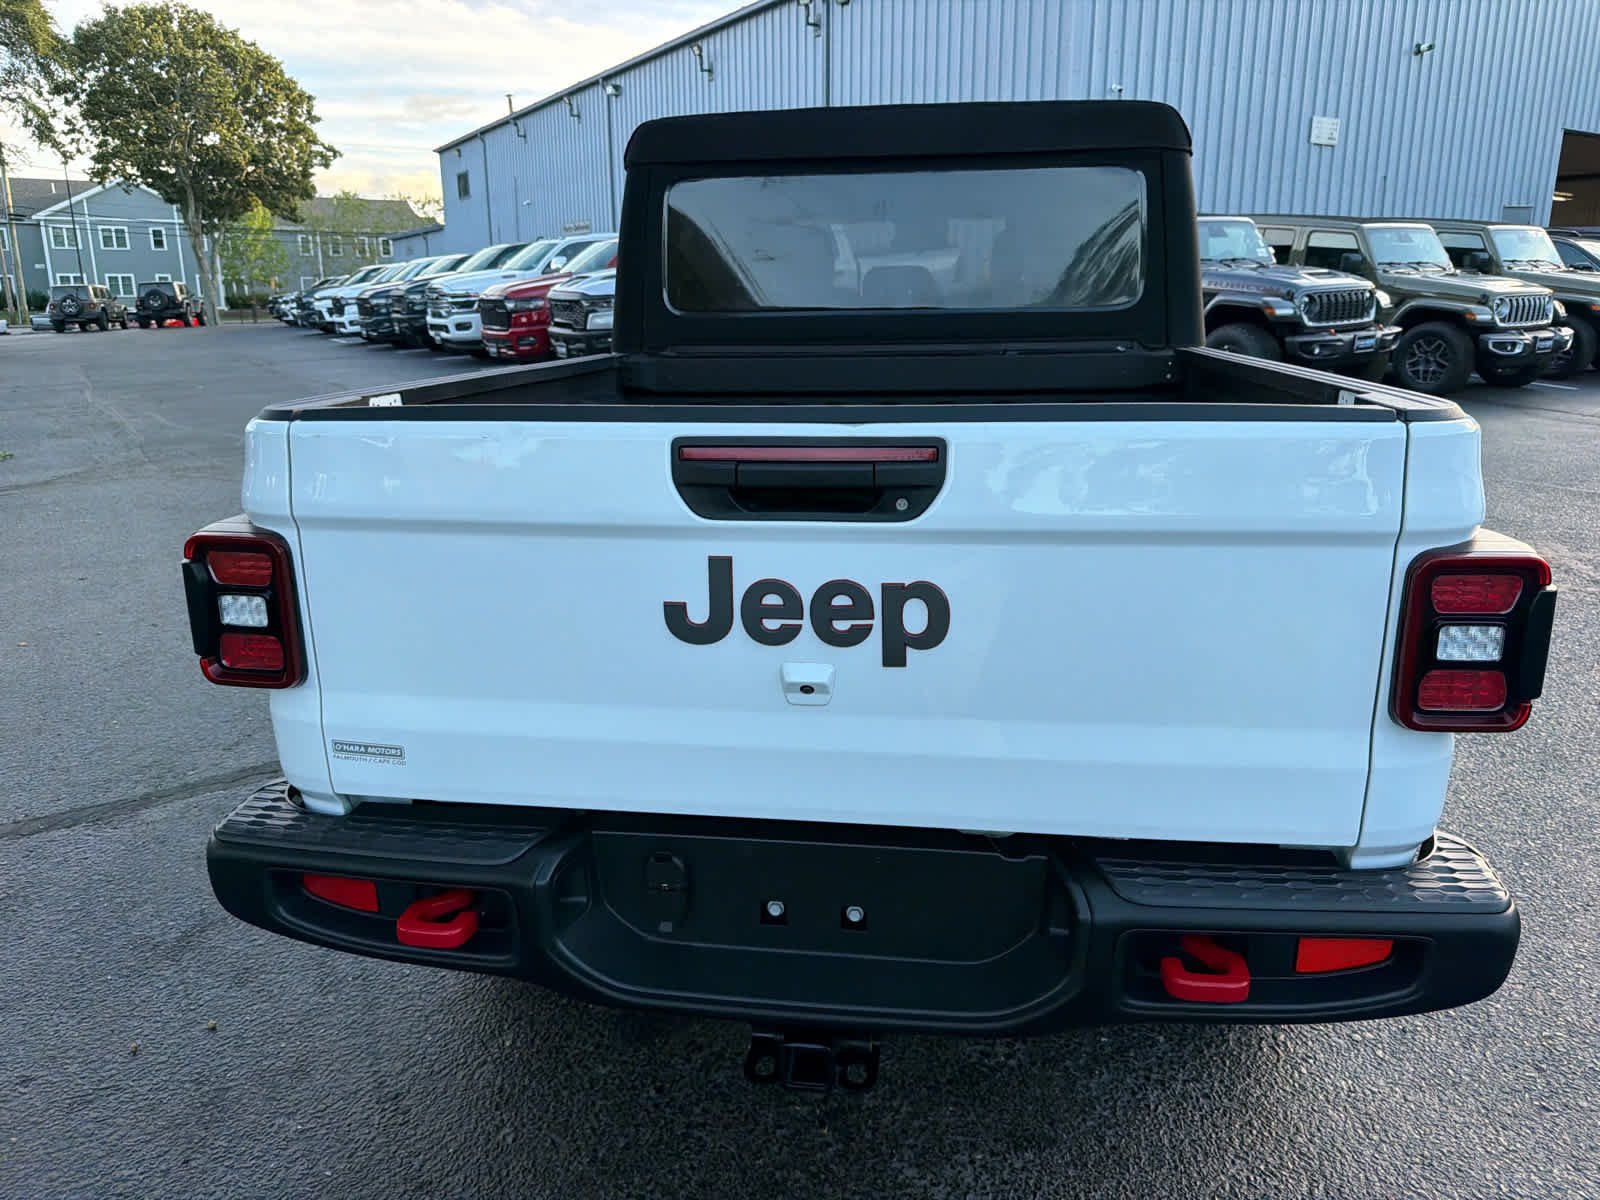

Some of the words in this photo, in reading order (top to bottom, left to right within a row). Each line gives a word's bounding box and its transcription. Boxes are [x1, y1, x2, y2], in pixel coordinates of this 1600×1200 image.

[663, 555, 950, 668] Jeep
[335, 743, 366, 752] O'HARA
[367, 746, 401, 756] MOTORS
